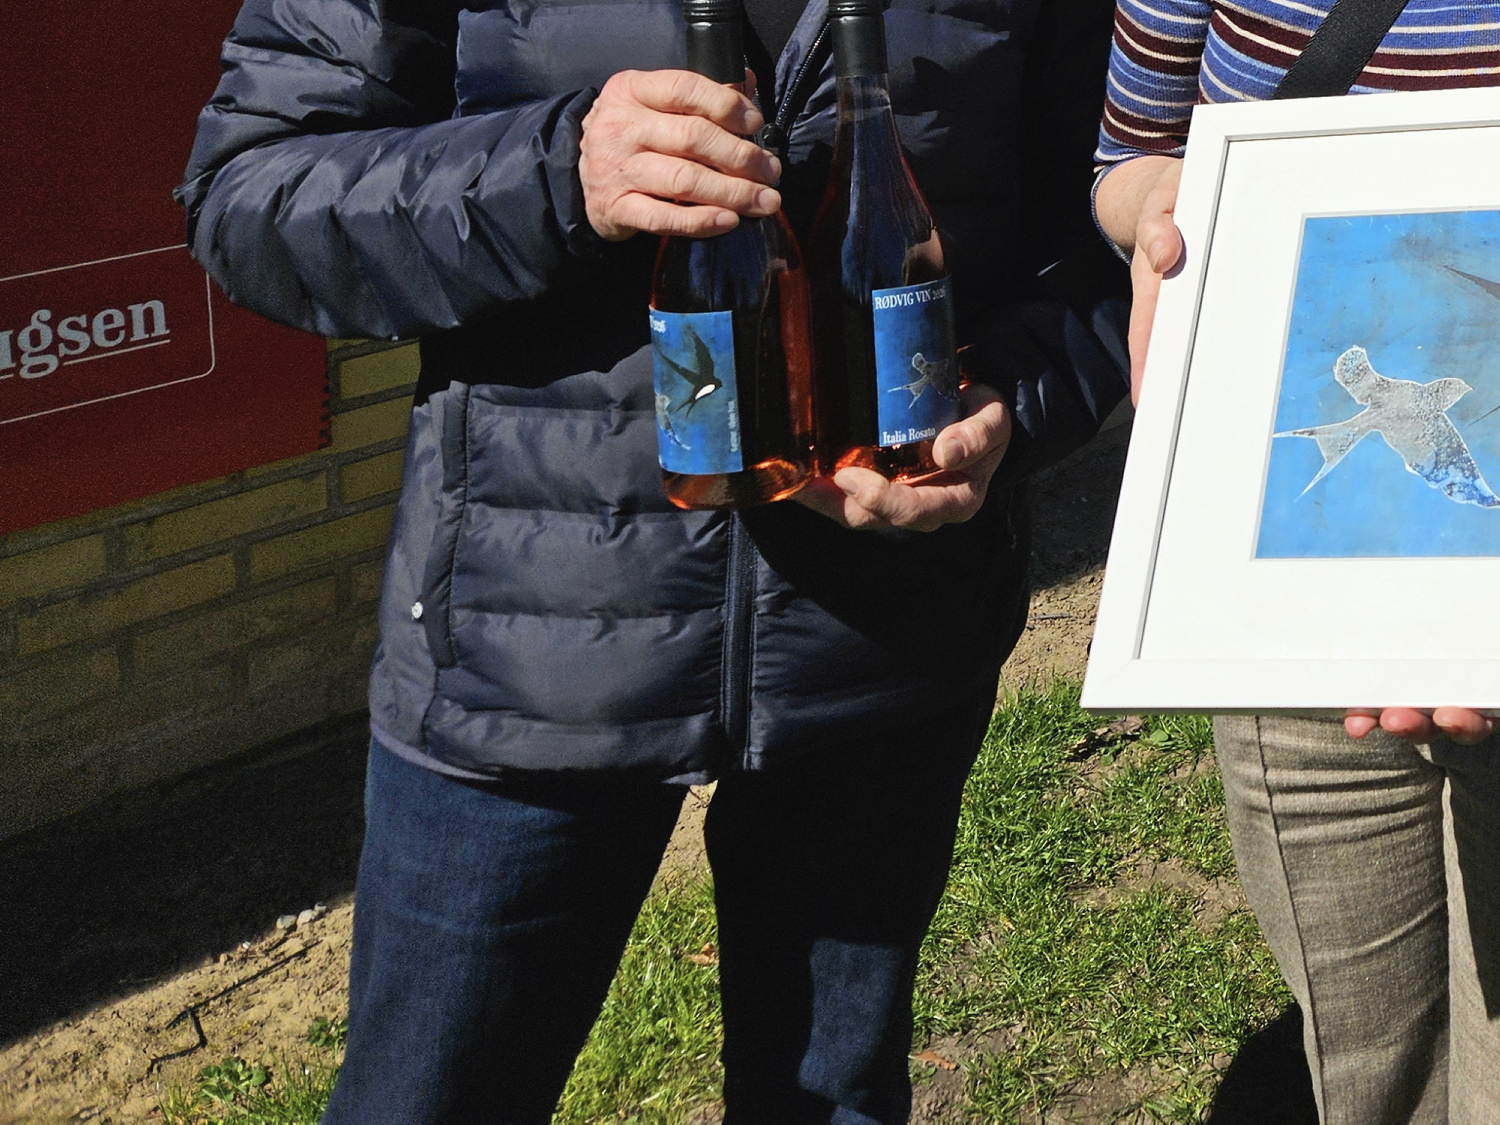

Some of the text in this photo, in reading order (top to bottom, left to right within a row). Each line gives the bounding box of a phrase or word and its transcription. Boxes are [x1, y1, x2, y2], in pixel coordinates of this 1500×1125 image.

[875, 292, 914, 310] RØDVIG
[915, 289, 931, 302] VIN
[883, 428, 936, 444] Italia Rosato
